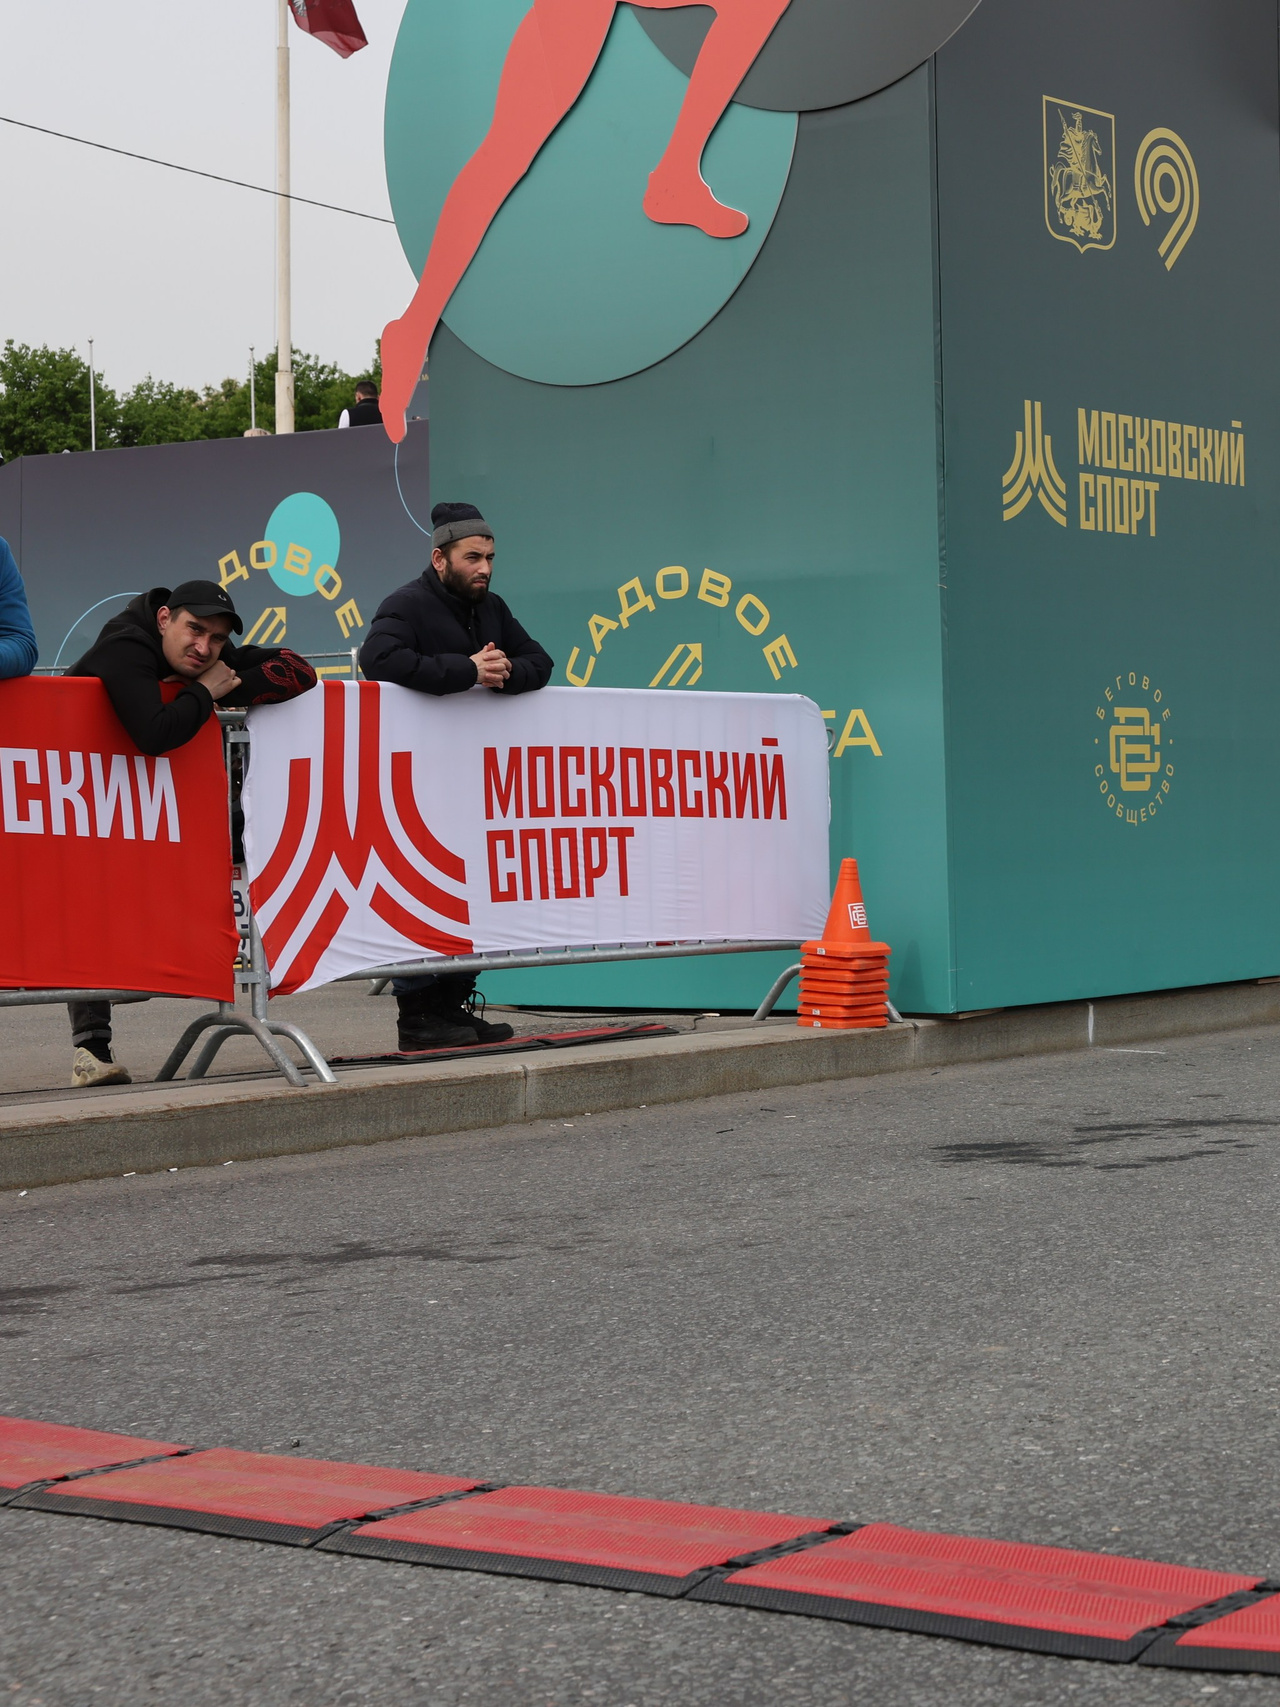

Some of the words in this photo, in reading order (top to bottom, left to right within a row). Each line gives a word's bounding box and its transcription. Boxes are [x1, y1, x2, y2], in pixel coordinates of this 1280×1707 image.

[1078, 407, 1245, 487] МОСКОВСКИЙ
[1079, 472, 1160, 537] СПОРТ
[218, 540, 364, 639] ДОВОЕ
[565, 565, 799, 688] САДОВОЕ
[1096, 671, 1171, 721] БЕГОВОЕ
[483, 737, 788, 820] МОСКОВСКИЙ
[1094, 764, 1174, 827] СООБЩЕСТВО
[486, 826, 635, 903] СПОРТ
